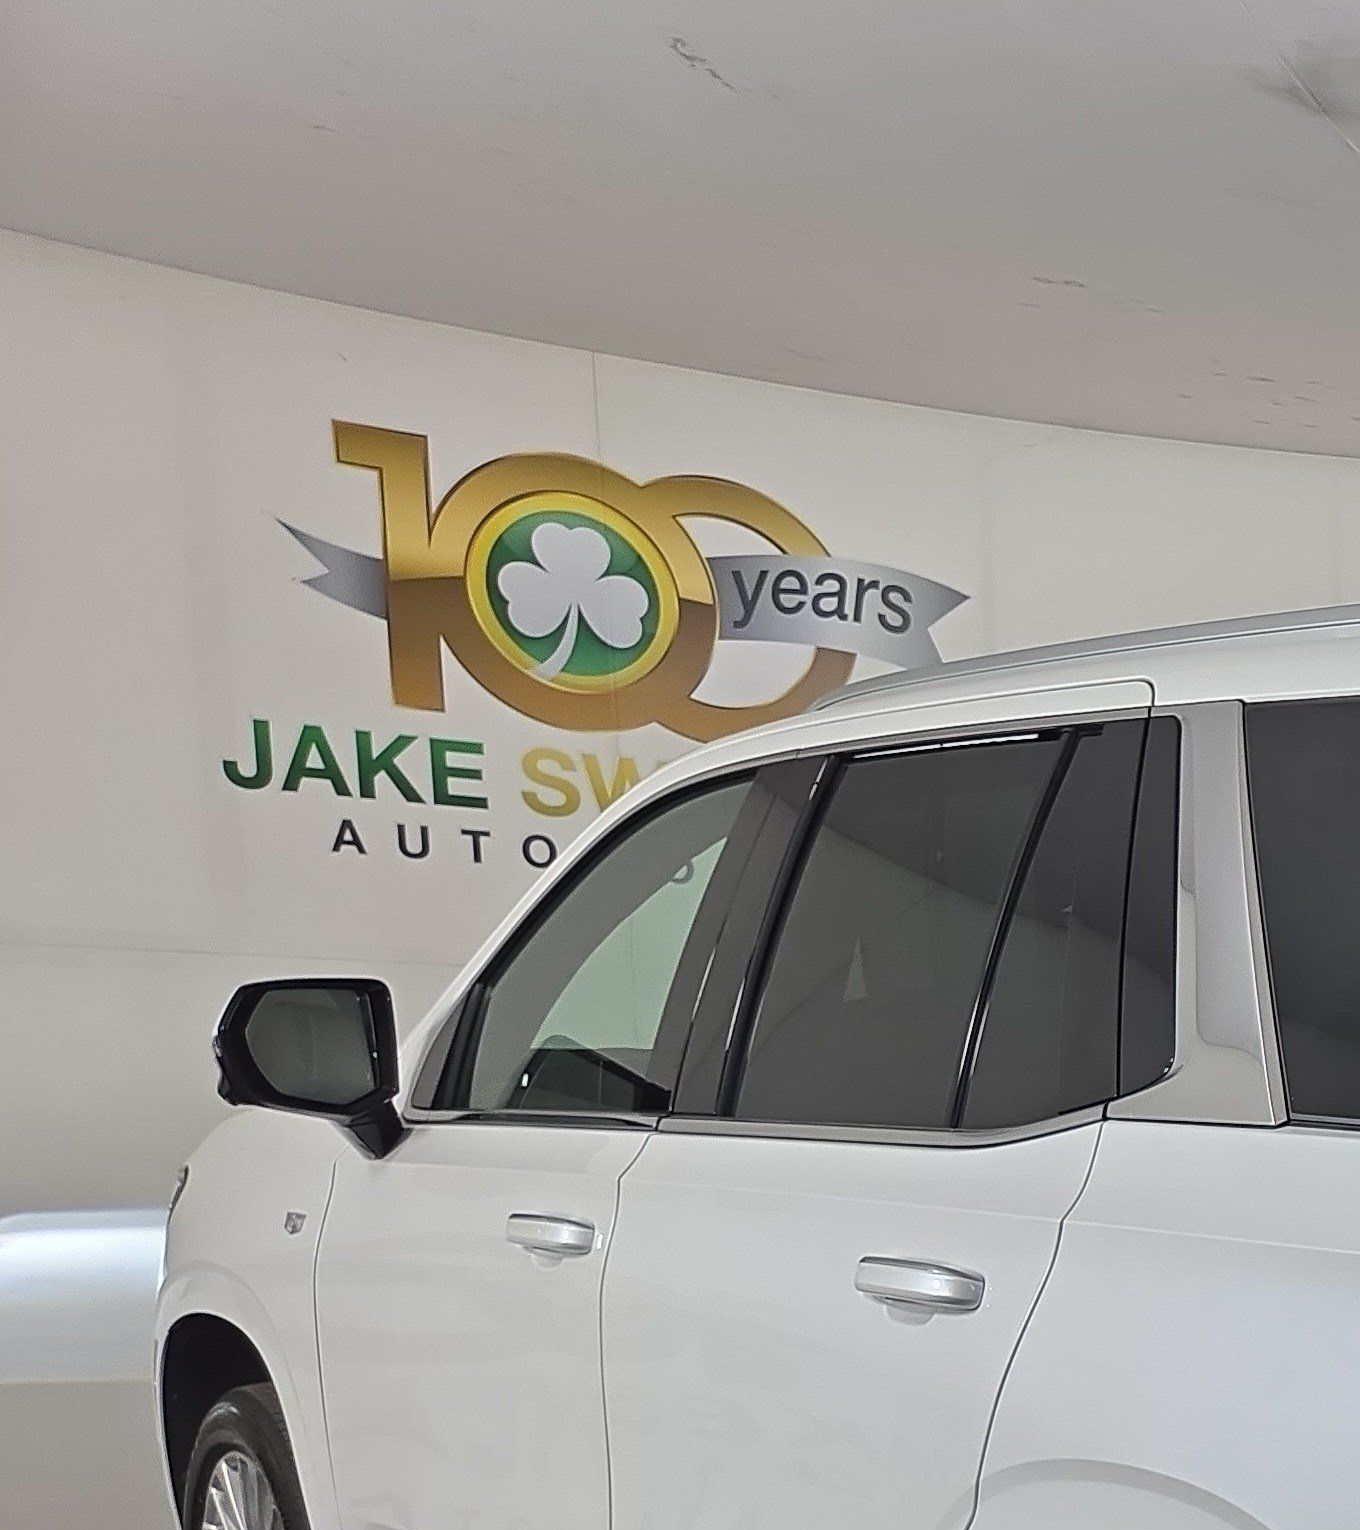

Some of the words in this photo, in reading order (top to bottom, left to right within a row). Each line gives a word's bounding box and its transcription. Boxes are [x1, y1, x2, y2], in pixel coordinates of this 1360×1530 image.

[730, 564, 915, 634] years
[222, 718, 489, 810] JAKE
[520, 746, 668, 818] SW
[331, 817, 560, 868] AUTO
